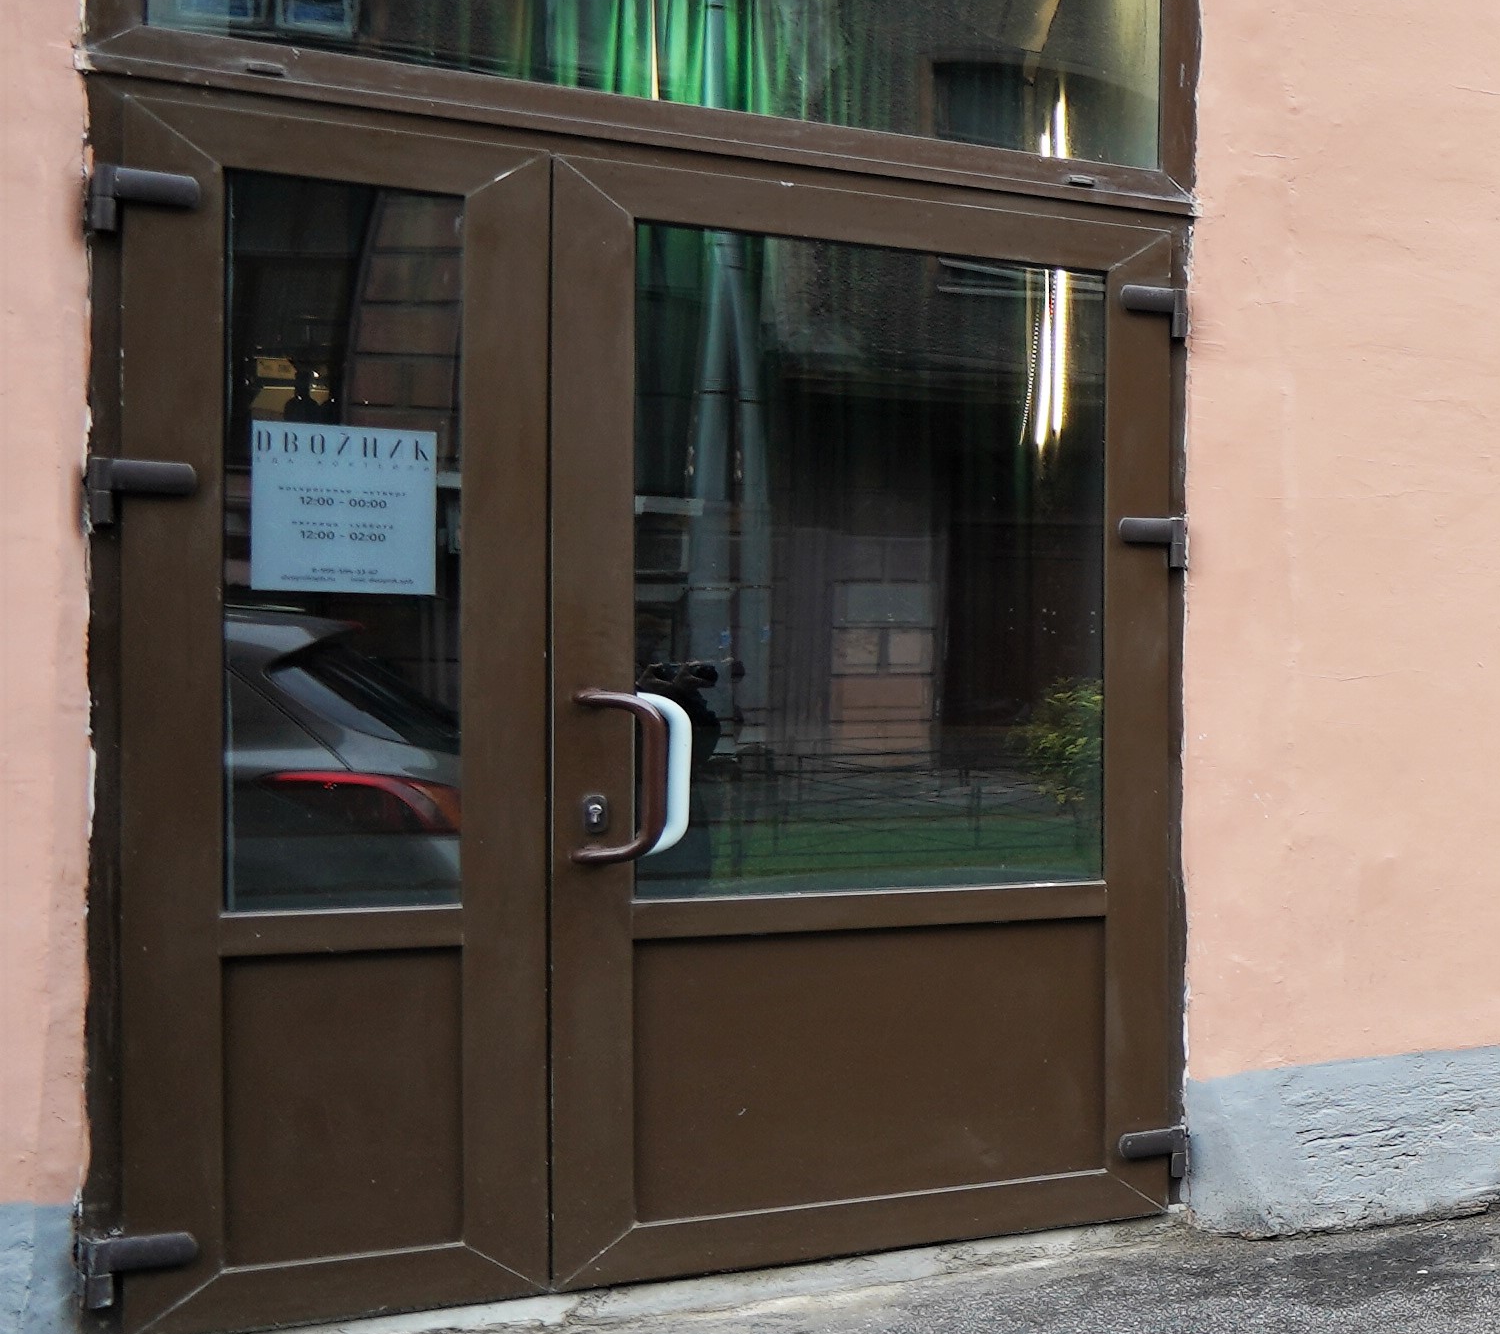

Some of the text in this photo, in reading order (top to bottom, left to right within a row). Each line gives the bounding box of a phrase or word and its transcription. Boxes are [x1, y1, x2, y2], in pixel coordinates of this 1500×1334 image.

[300, 496, 335, 506] 12:00
[349, 498, 387, 509] 00:00
[300, 530, 335, 540] 12:00
[349, 532, 386, 542] 02:00
